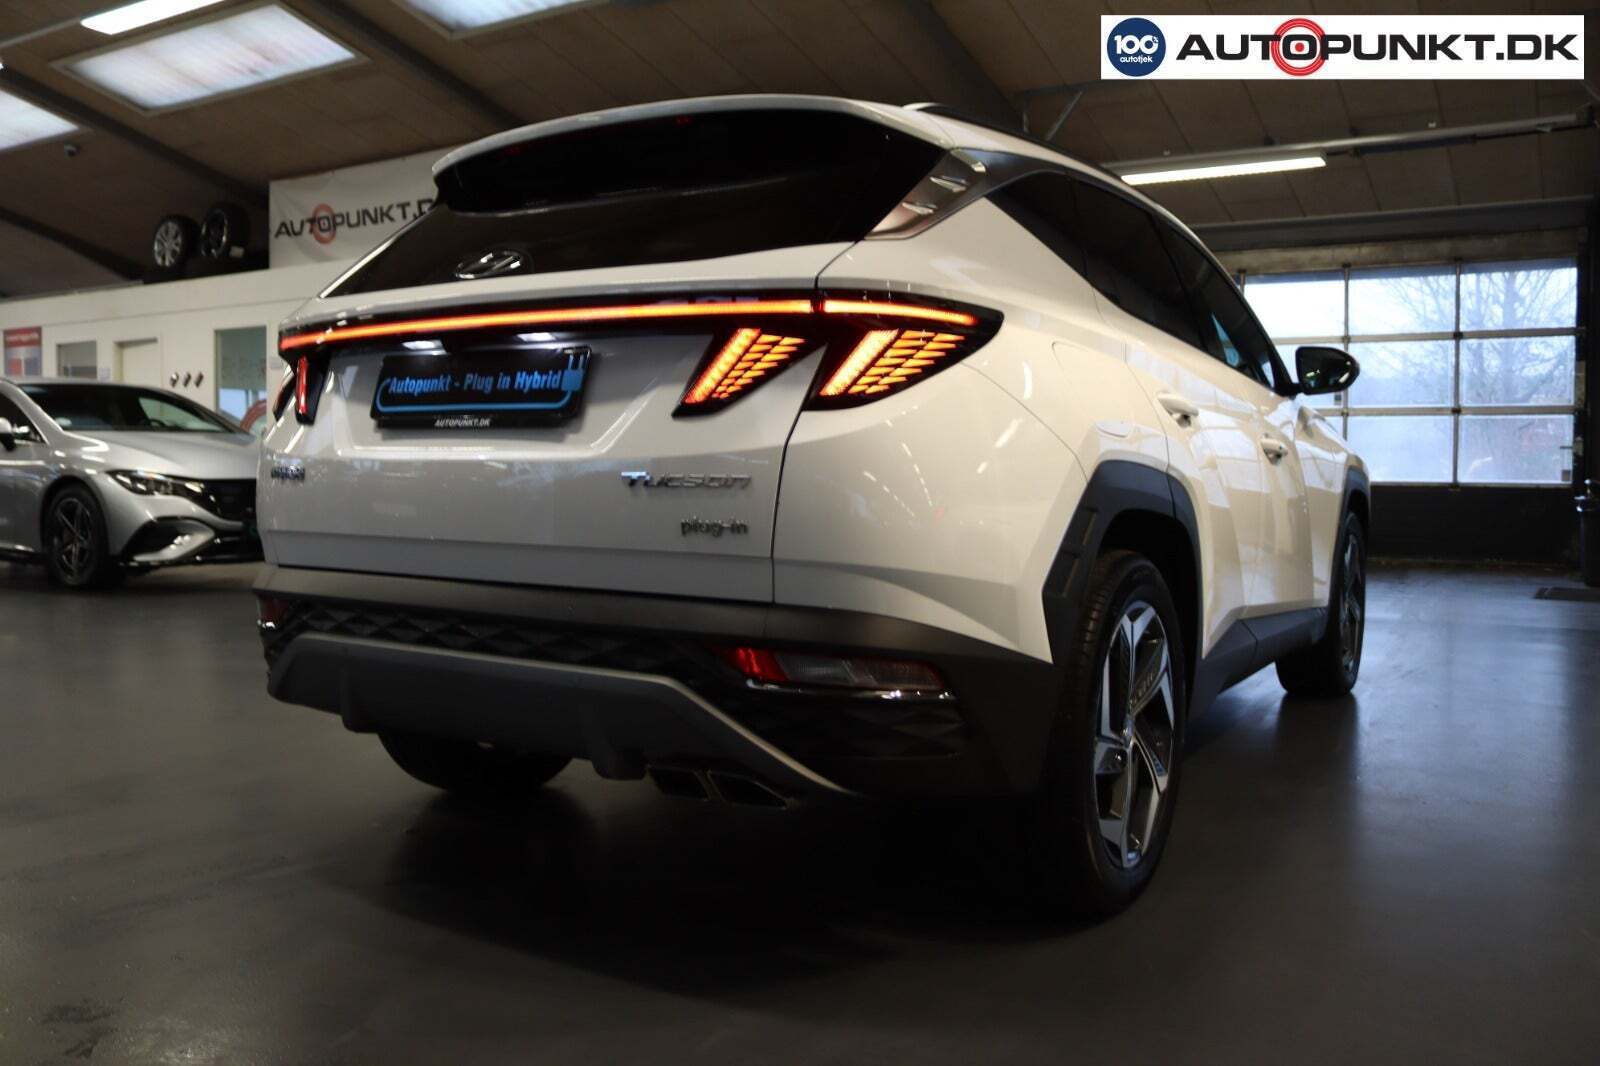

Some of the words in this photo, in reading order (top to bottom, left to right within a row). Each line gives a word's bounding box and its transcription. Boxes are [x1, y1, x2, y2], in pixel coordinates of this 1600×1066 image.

[388, 376, 452, 396] Autopunkt
[464, 373, 493, 394] Plug
[497, 373, 511, 390] in
[514, 370, 562, 392] Hybrid
[434, 418, 490, 427] AUTOPUNKT.DK
[681, 516, 748, 538] plug-in
